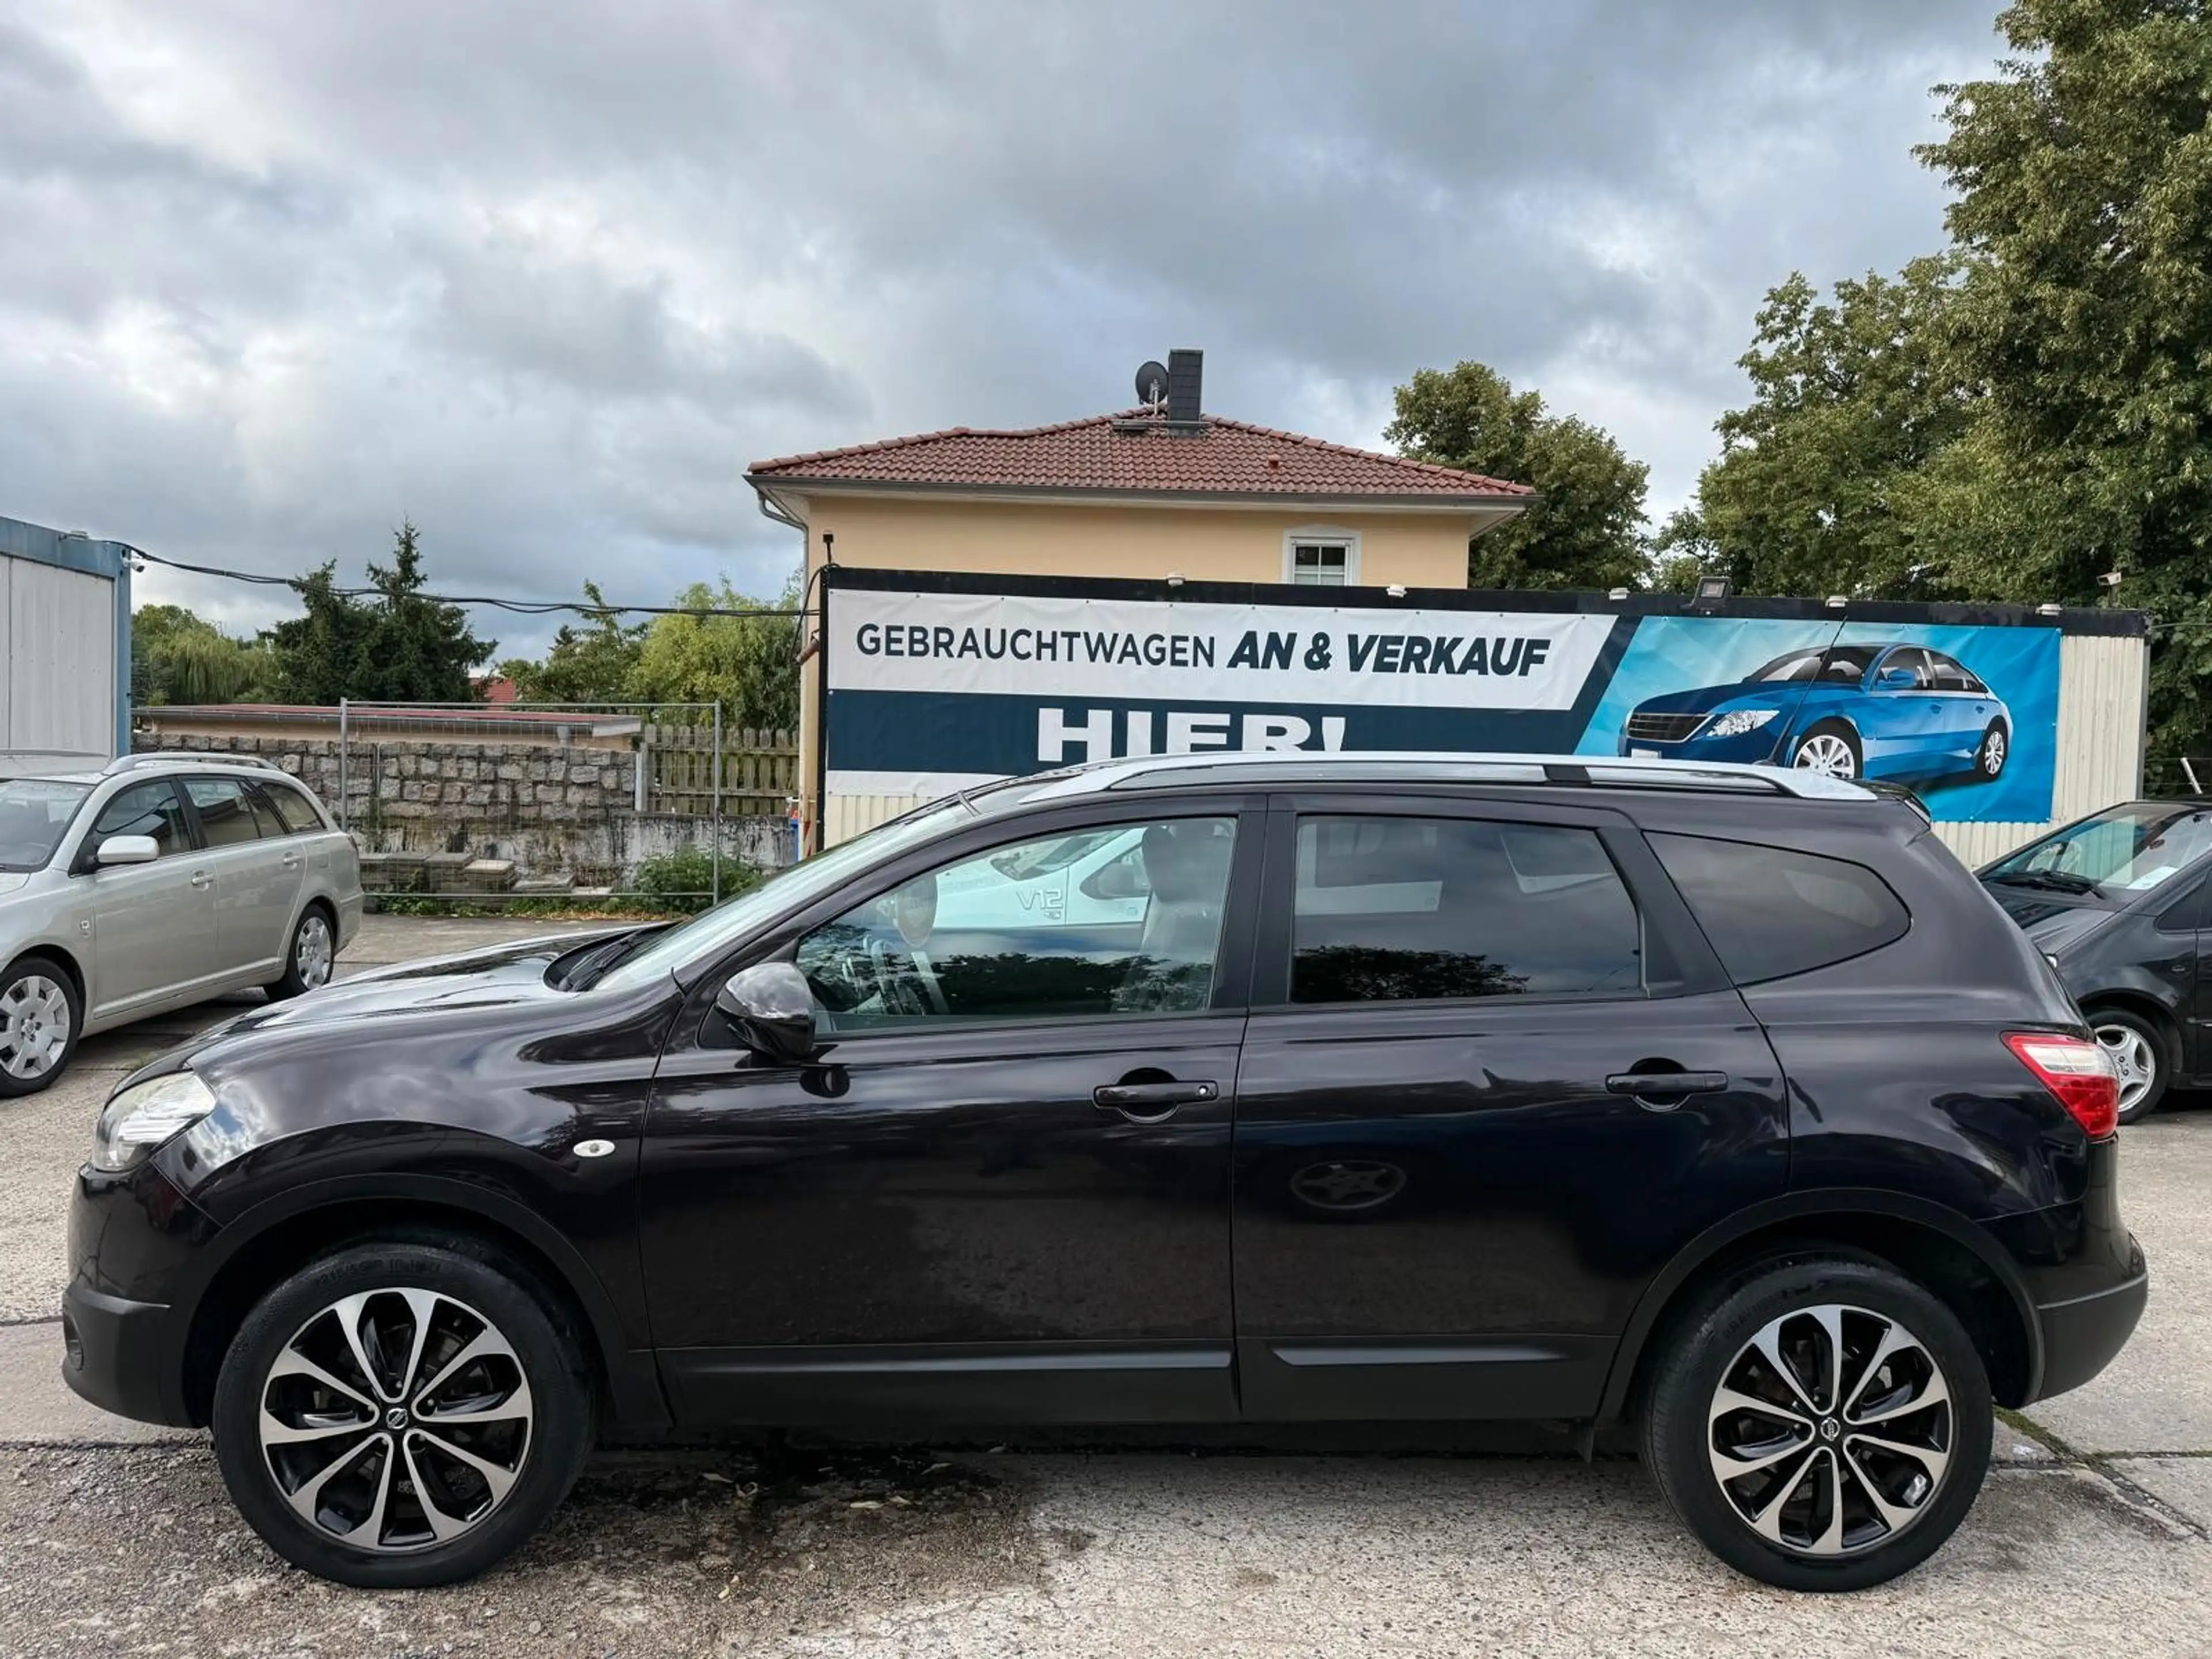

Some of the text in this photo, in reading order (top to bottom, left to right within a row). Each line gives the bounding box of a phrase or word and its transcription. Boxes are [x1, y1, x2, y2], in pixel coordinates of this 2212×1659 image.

[857, 624, 1550, 676] GEBRAUCHTWAGEN AN & VERKAUF
[1016, 889, 1063, 910] V12
